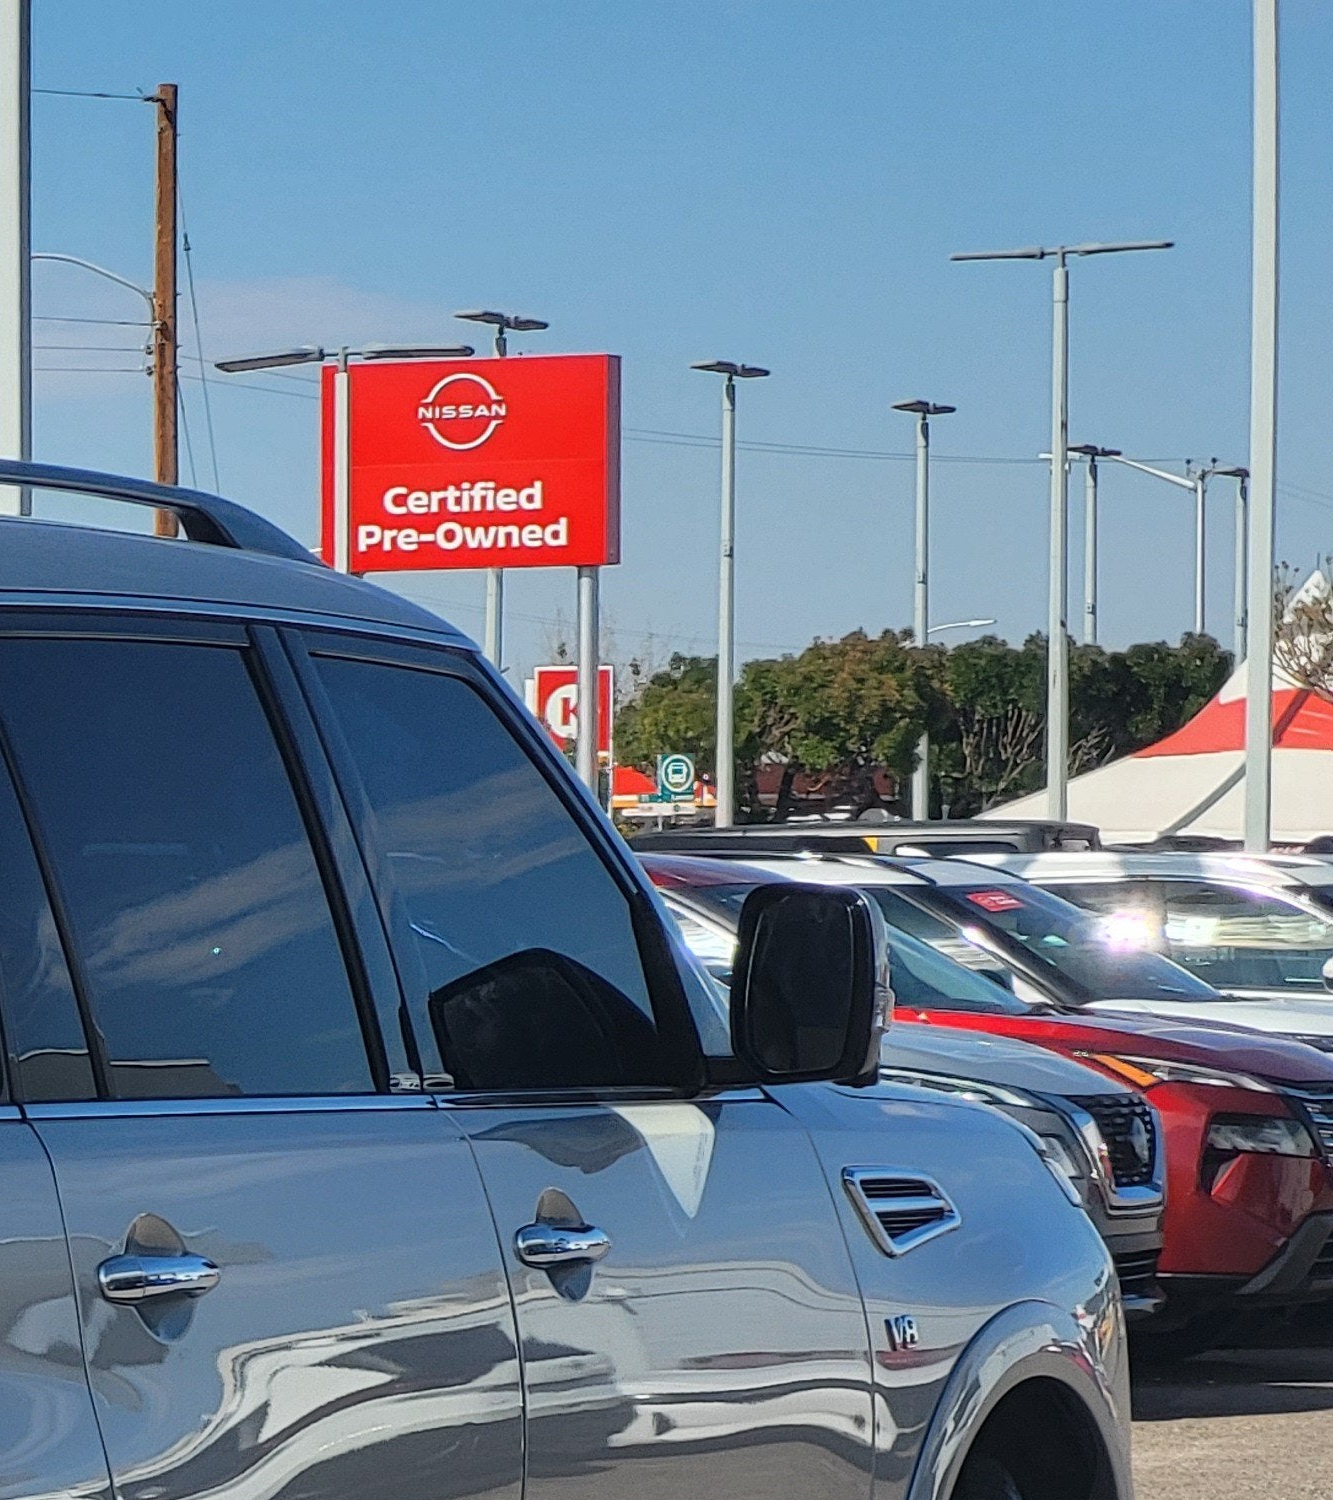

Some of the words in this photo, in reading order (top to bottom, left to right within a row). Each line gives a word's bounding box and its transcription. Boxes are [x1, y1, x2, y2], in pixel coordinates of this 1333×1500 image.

[417, 403, 507, 420] NISSAN
[383, 481, 544, 515] Certified
[357, 517, 569, 552] Pre-Owned
